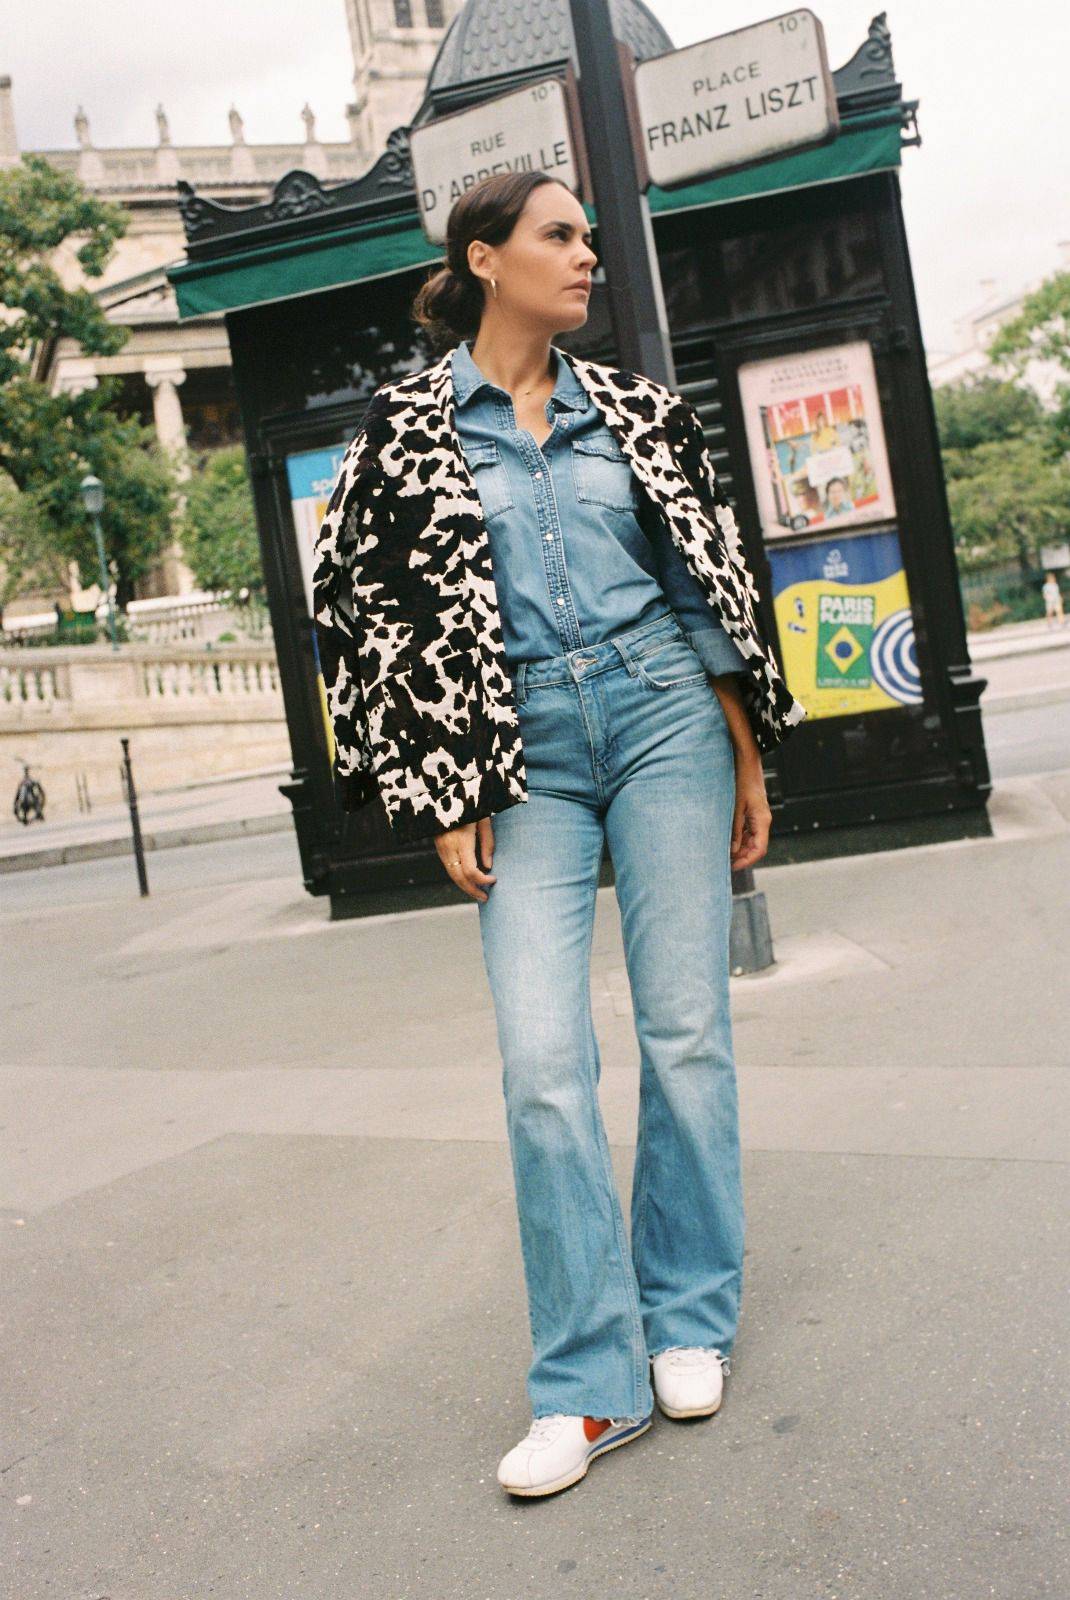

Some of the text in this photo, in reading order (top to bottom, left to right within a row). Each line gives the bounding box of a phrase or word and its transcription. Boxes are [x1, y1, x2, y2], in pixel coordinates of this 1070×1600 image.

[692, 61, 761, 96] PLACE
[647, 76, 818, 150] FRANZ LISZT
[470, 131, 506, 156] RUE
[820, 596, 874, 612] PARIS
